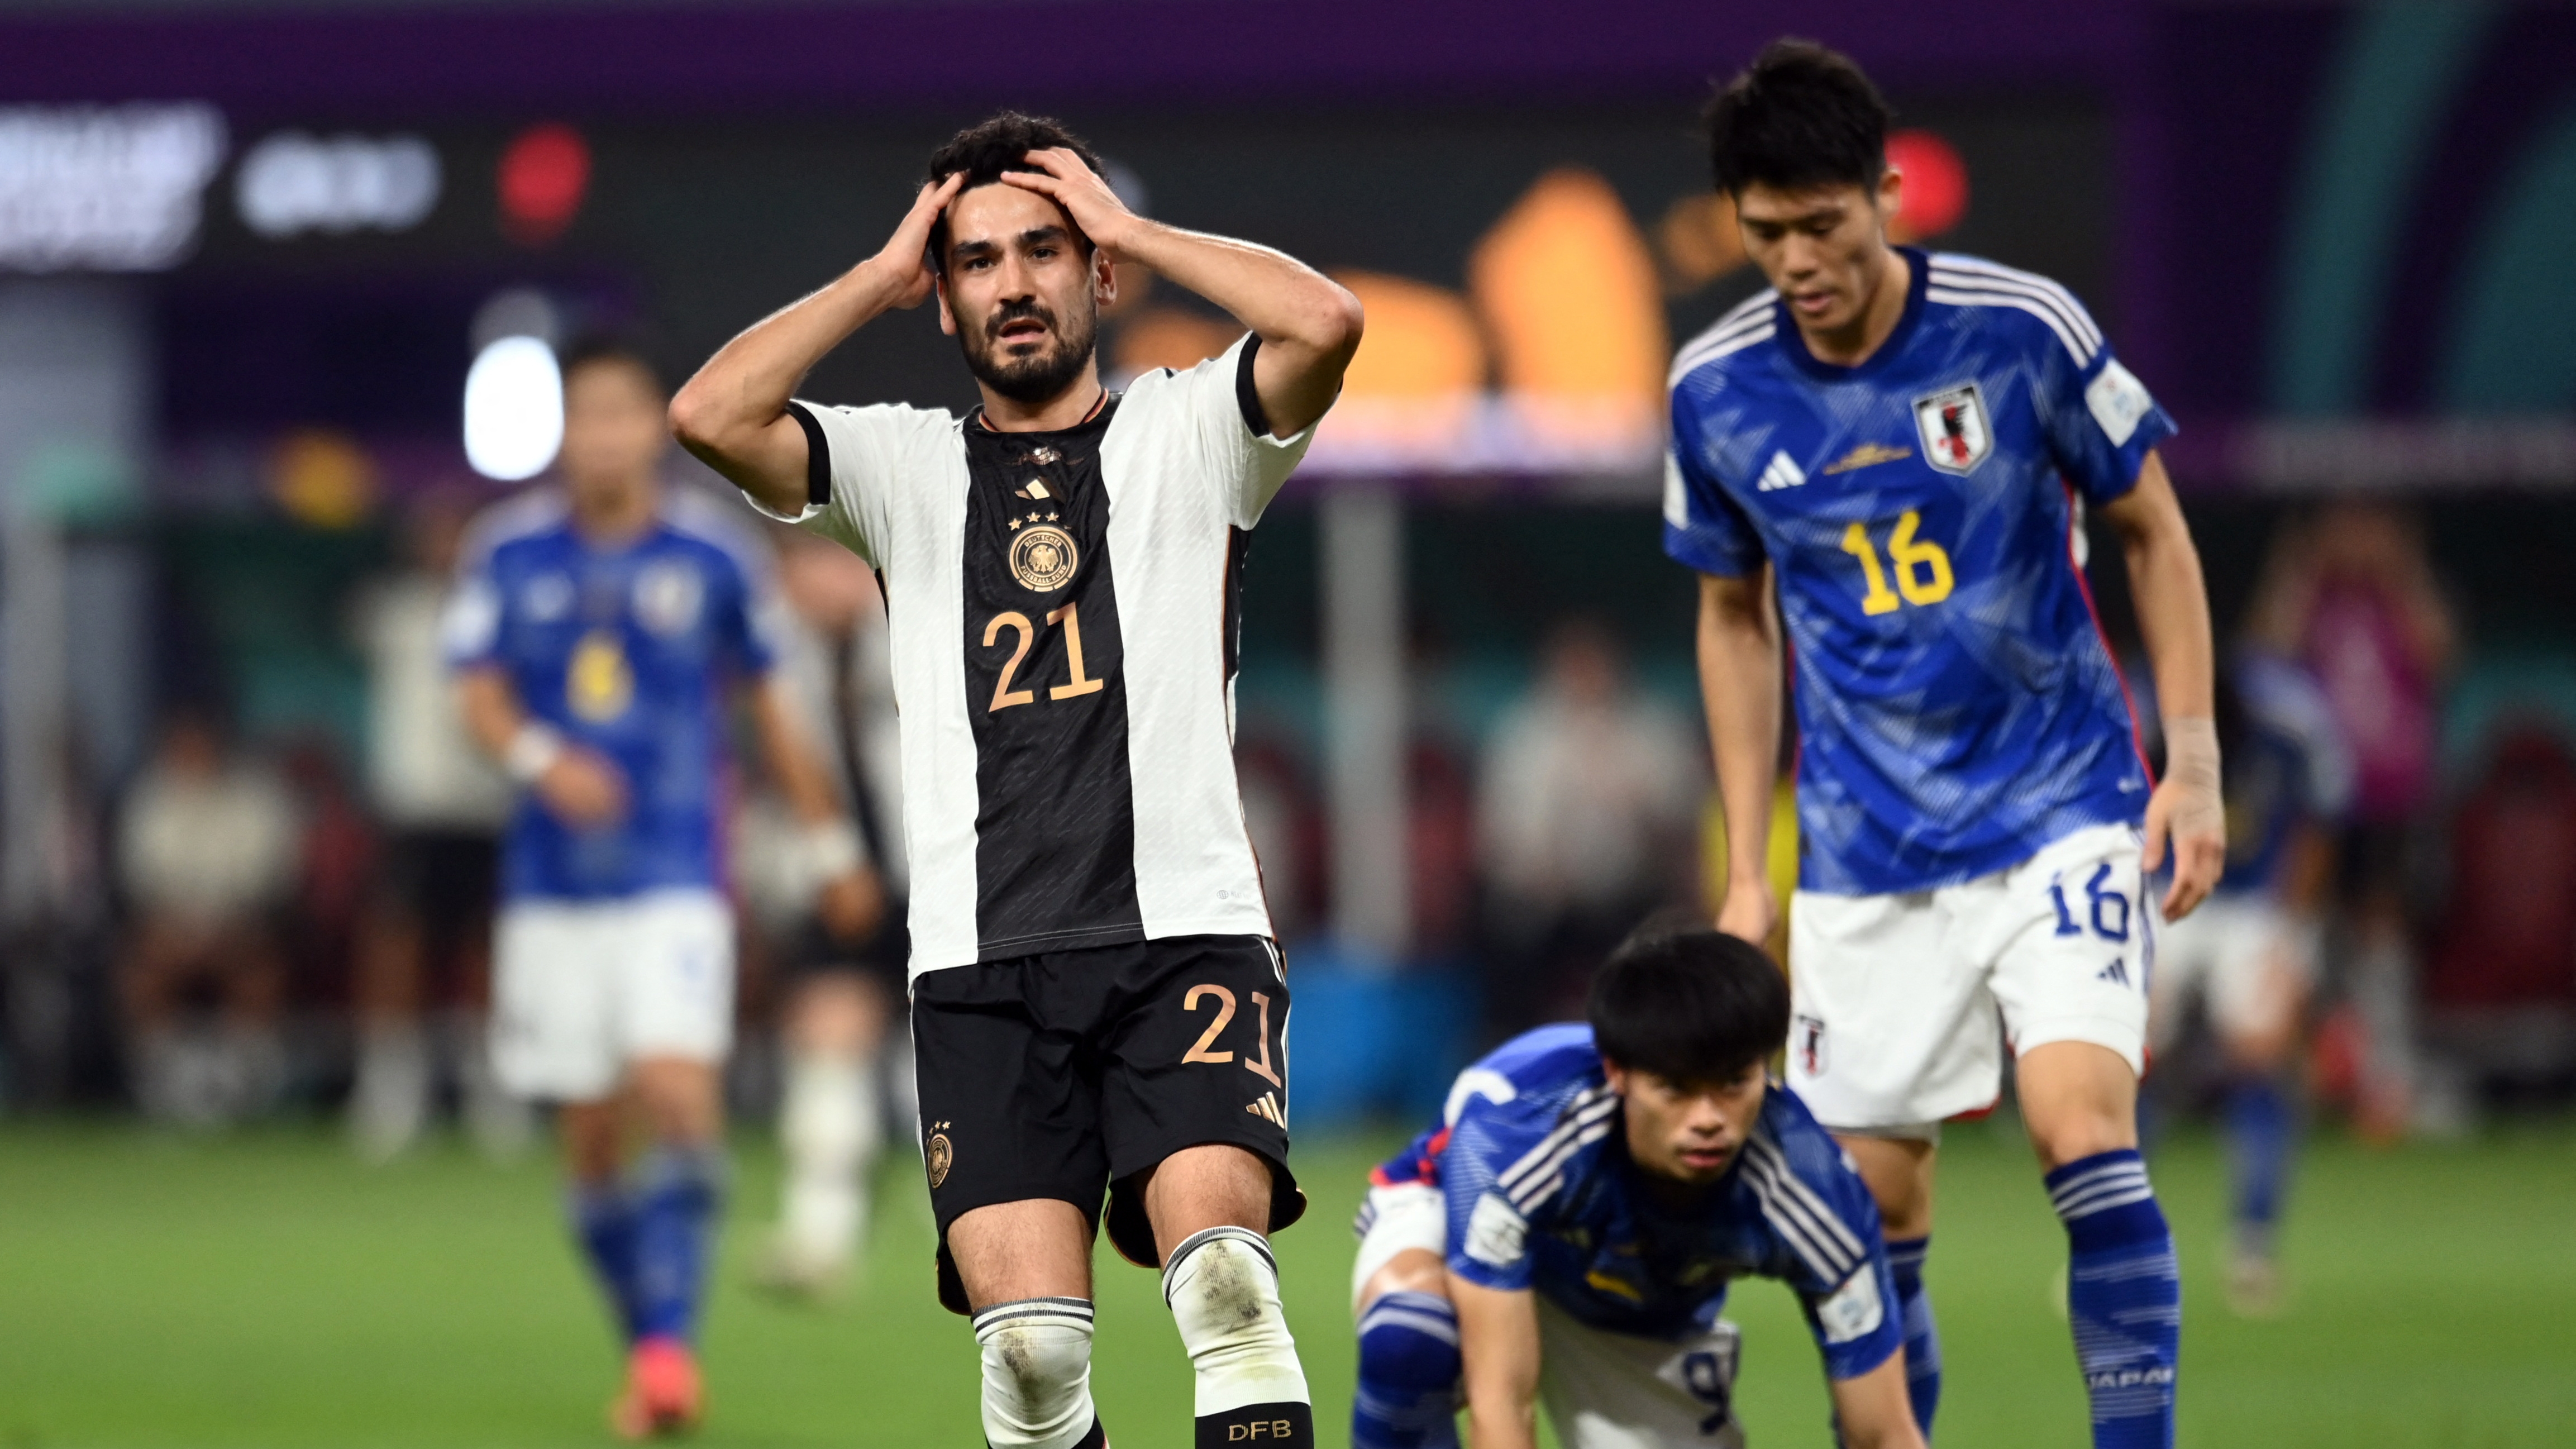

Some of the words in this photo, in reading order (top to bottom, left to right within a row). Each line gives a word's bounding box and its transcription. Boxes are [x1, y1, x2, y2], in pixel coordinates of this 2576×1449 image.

[1020, 565, 1067, 583] FUSSBALL-BUND
[1024, 535, 1062, 547] DEUTSCHER
[1842, 509, 1954, 615] 16
[982, 601, 1103, 713] 21
[2049, 862, 2129, 942] 16
[1181, 984, 1281, 1088] 21
[1228, 1419, 1291, 1441] DFB
